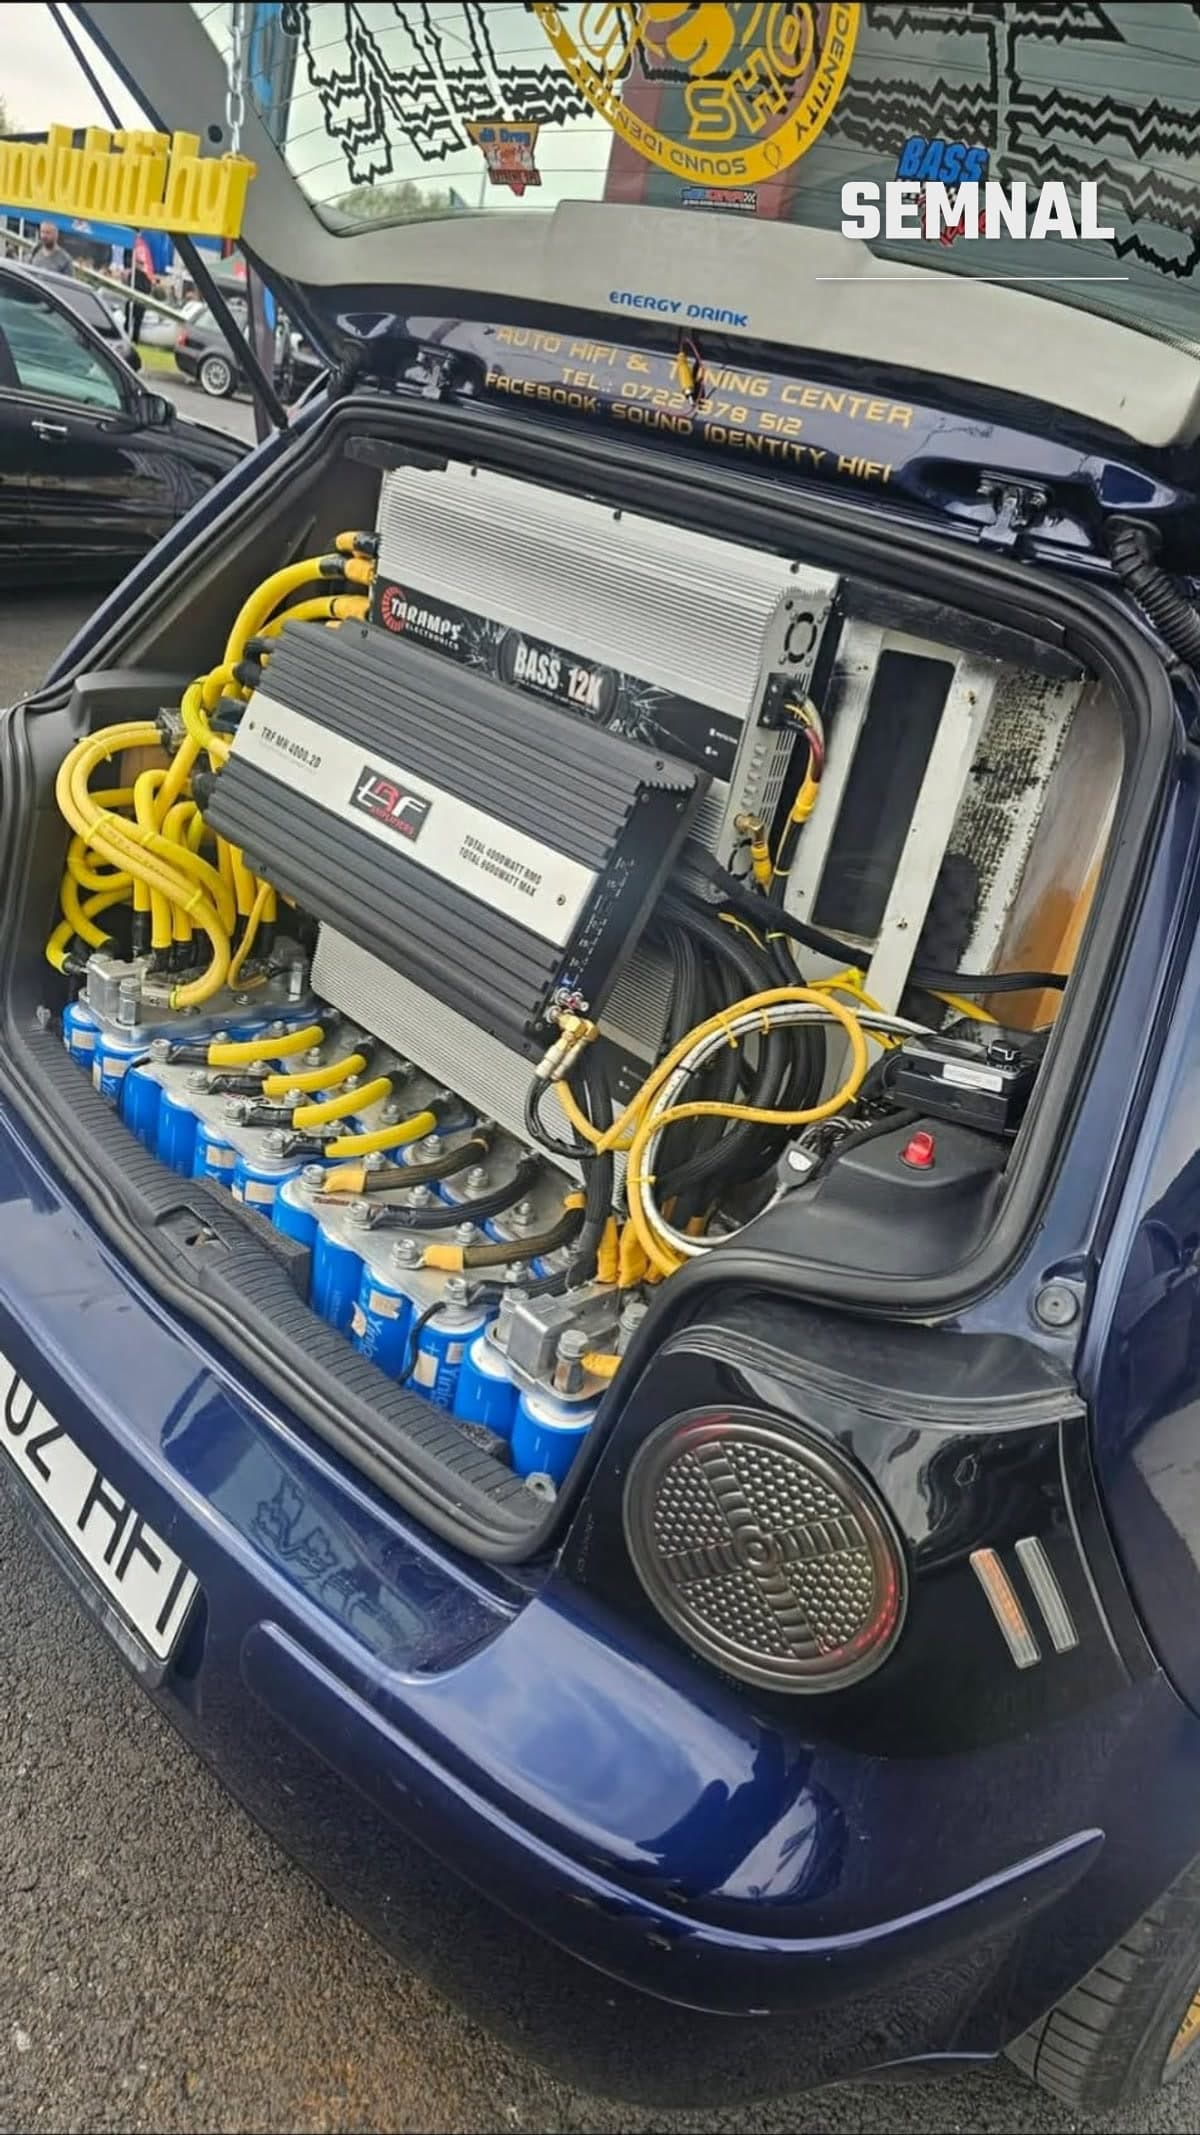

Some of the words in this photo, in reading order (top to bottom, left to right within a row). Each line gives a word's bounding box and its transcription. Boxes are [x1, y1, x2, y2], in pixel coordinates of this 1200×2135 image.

[670, 150, 747, 175] SOUND
[900, 136, 989, 183] BASS
[496, 327, 562, 352] AUTO
[568, 342, 619, 366] HIFI
[626, 353, 649, 373] &
[668, 361, 771, 397] TNING
[781, 384, 914, 429] CENTER
[621, 382, 687, 409] 0722
[697, 398, 748, 423] 378
[759, 412, 803, 436] 512
[611, 402, 694, 436] SOUND
[704, 423, 827, 468] IDENTITY
[838, 454, 893, 483] HIFI
[391, 598, 461, 641] TARAMPS
[405, 623, 459, 650] ELECTRONICS
[513, 644, 560, 689] BASS
[568, 667, 605, 709] 12K
[459, 847, 481, 864] TOTAL
[518, 880, 537, 897] MAX
[464, 835, 485, 852] TOTAL
[523, 868, 542, 885] RMS
[78, 1471, 192, 1635] HFI
